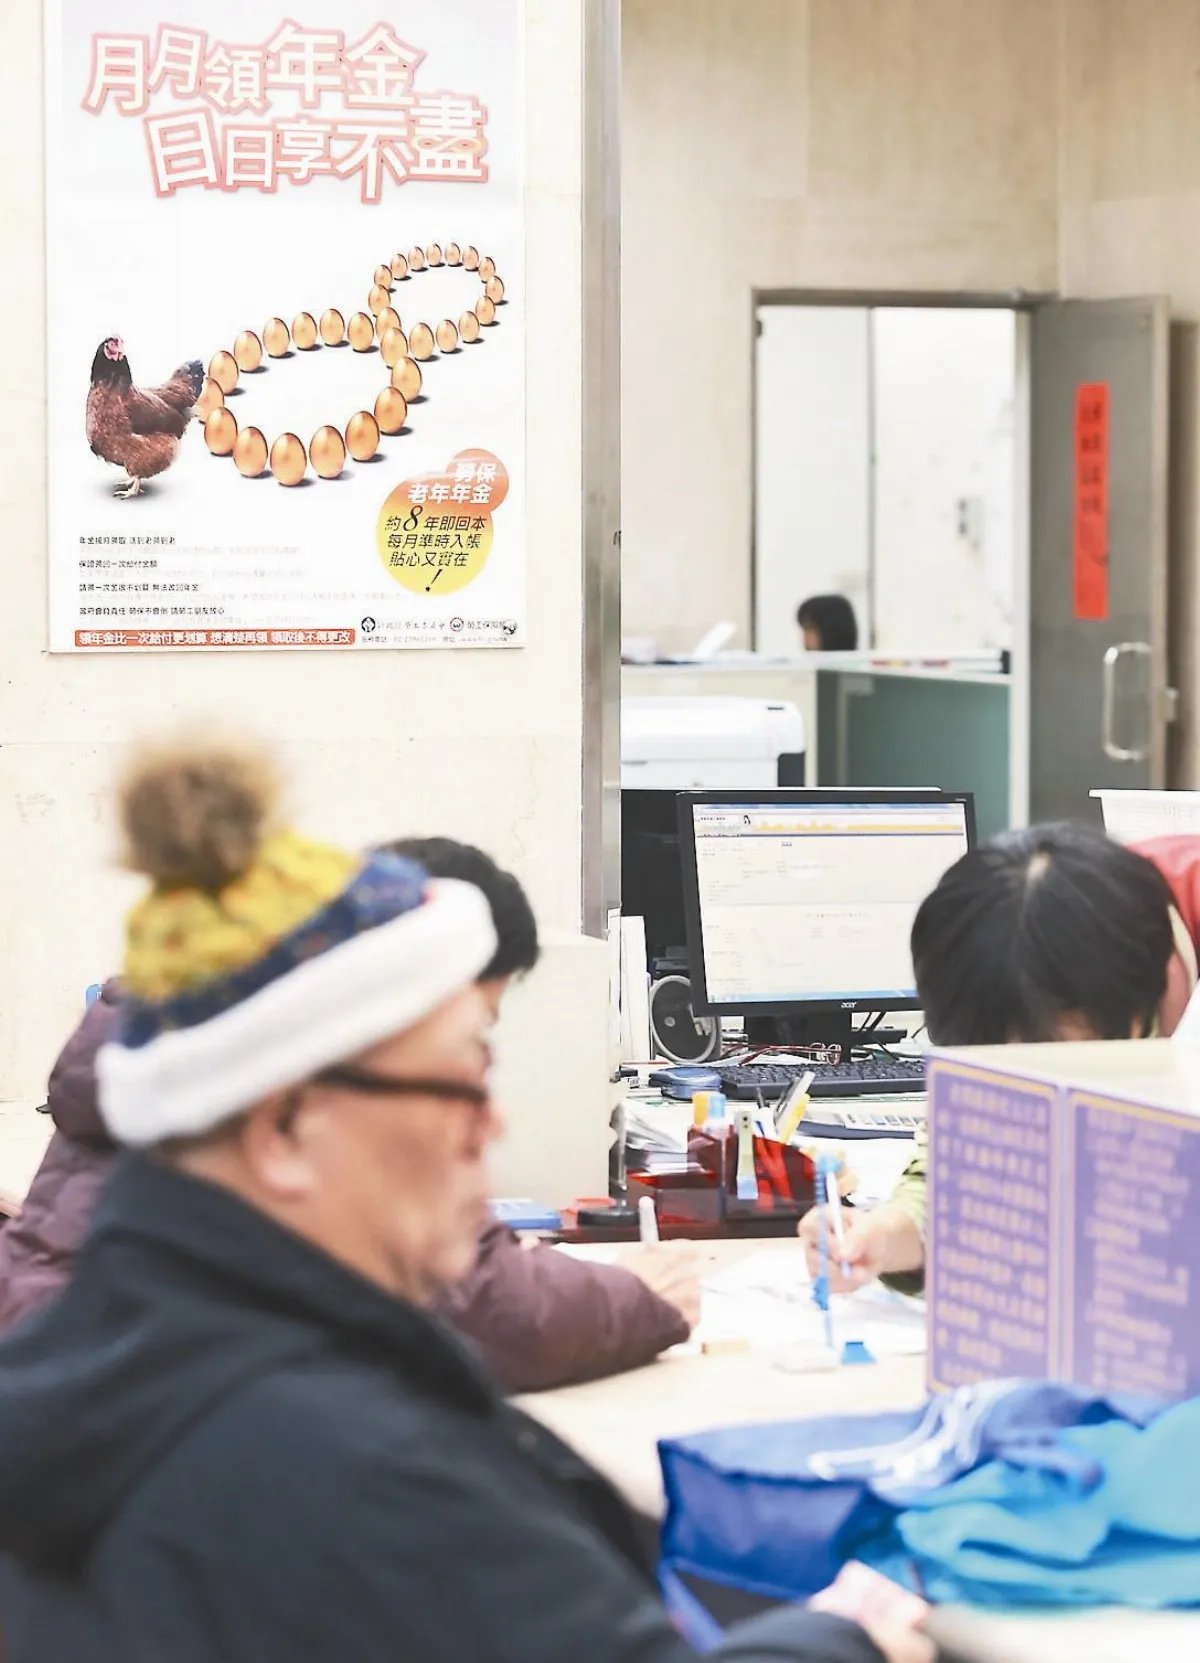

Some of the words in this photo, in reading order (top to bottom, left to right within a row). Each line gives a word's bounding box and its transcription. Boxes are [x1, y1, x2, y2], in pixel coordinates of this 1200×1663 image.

[84, 20, 424, 114] 月月領年金
[144, 92, 487, 203] 日日享不盡
[407, 483, 493, 504] 老年年金
[387, 533, 483, 549] 每月準時入帳
[389, 551, 469, 567] 貼心又實在
